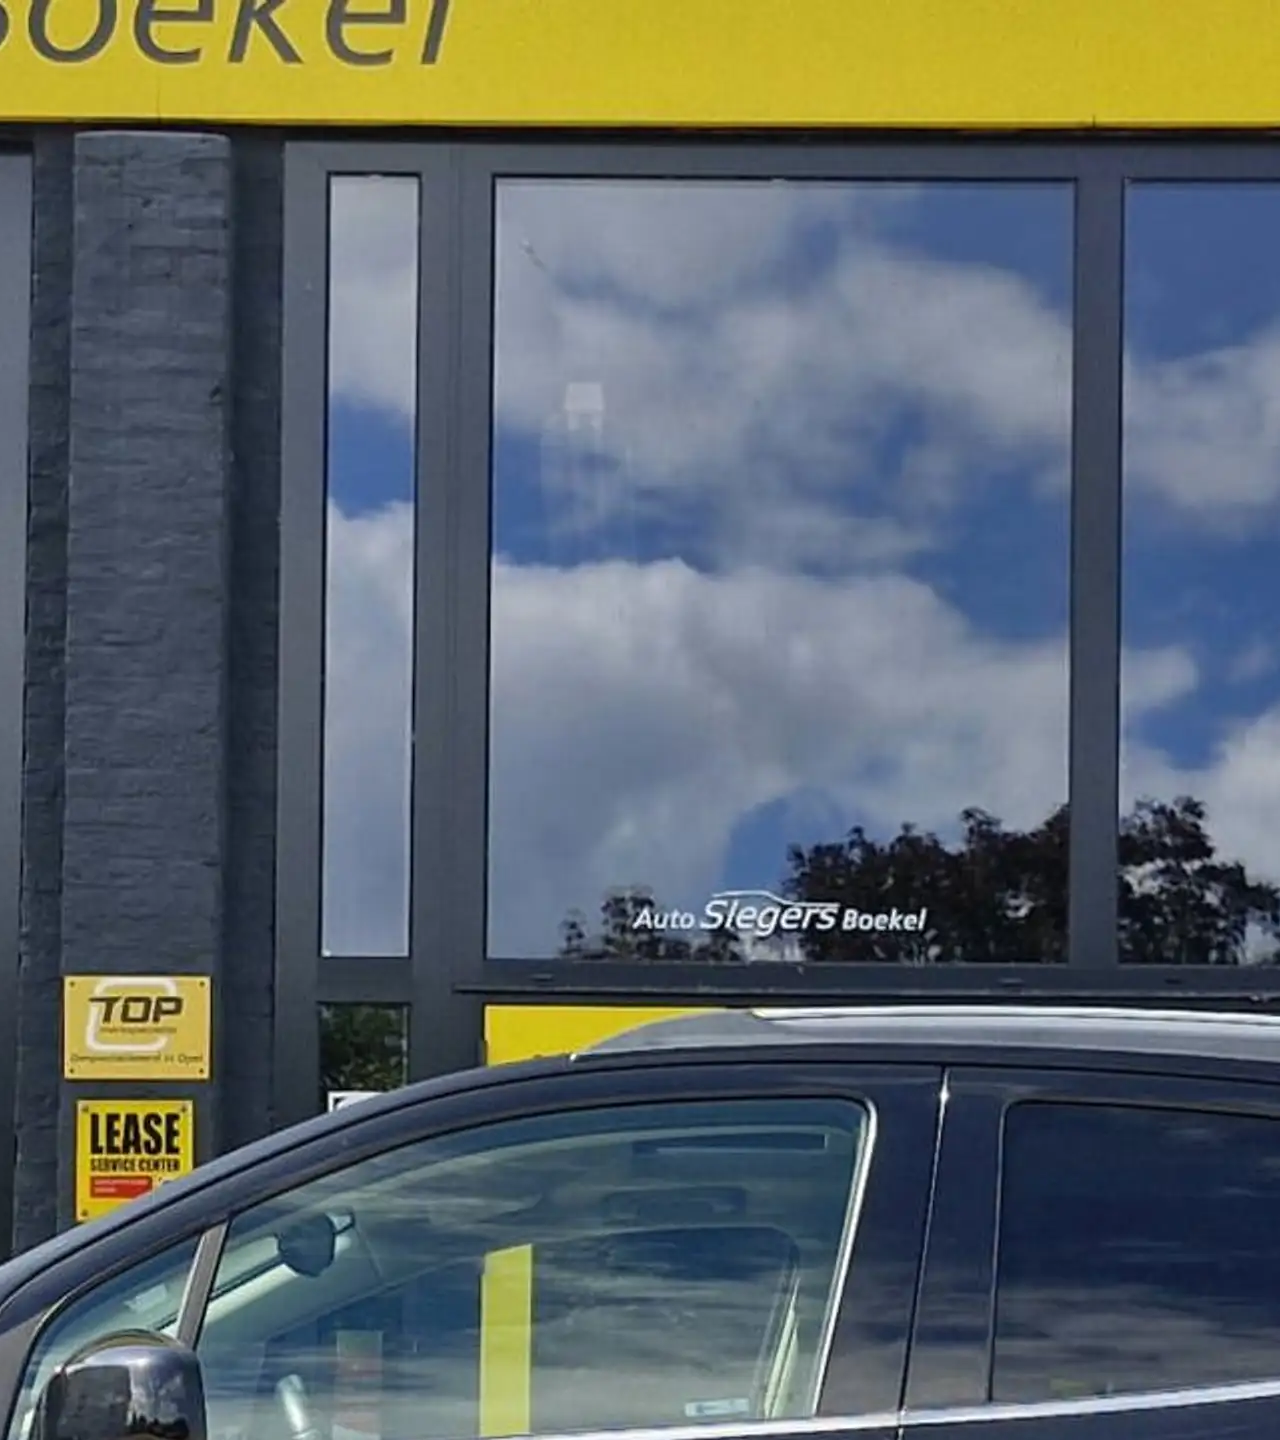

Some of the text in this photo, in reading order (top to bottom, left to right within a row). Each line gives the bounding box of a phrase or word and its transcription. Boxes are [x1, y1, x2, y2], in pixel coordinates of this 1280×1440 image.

[632, 907, 696, 930] Auto
[842, 908, 928, 931] Boekel
[88, 996, 184, 1023] TOP
[91, 1113, 180, 1155] LEASE
[91, 1158, 180, 1172] SERVICE CENTER
